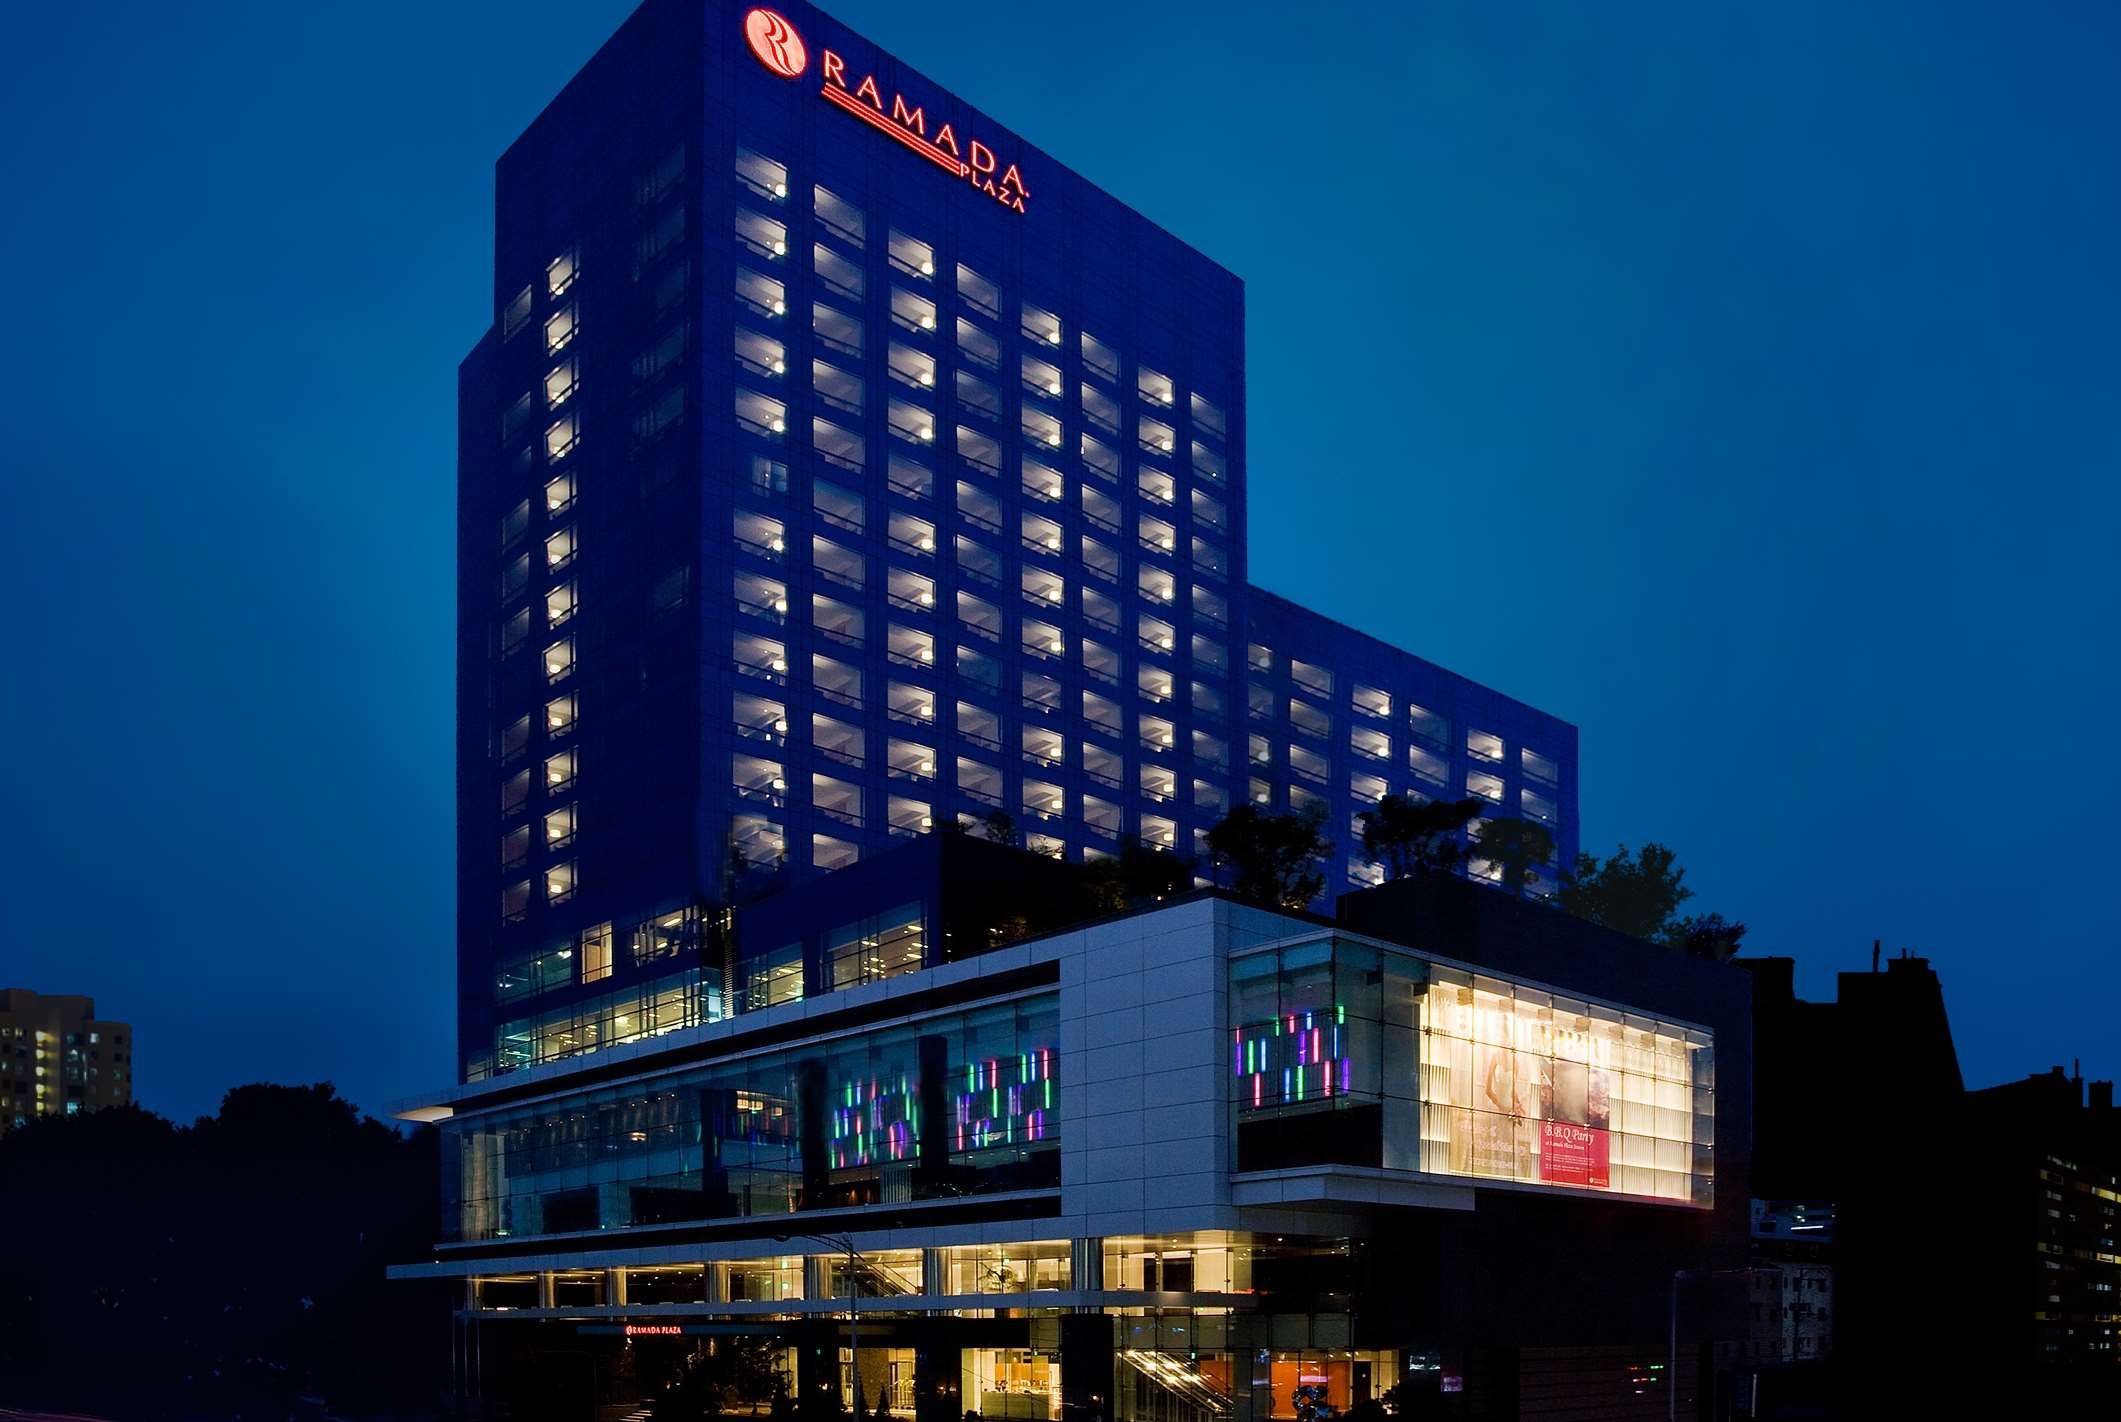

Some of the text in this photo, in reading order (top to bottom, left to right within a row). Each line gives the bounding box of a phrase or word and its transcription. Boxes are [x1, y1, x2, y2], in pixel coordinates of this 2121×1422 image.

[823, 49, 1025, 196] RAMADA
[959, 162, 1025, 214] PLAZA
[1572, 1129, 1594, 1145] Party
[632, 1326, 681, 1334] RAMADA PLAZA
